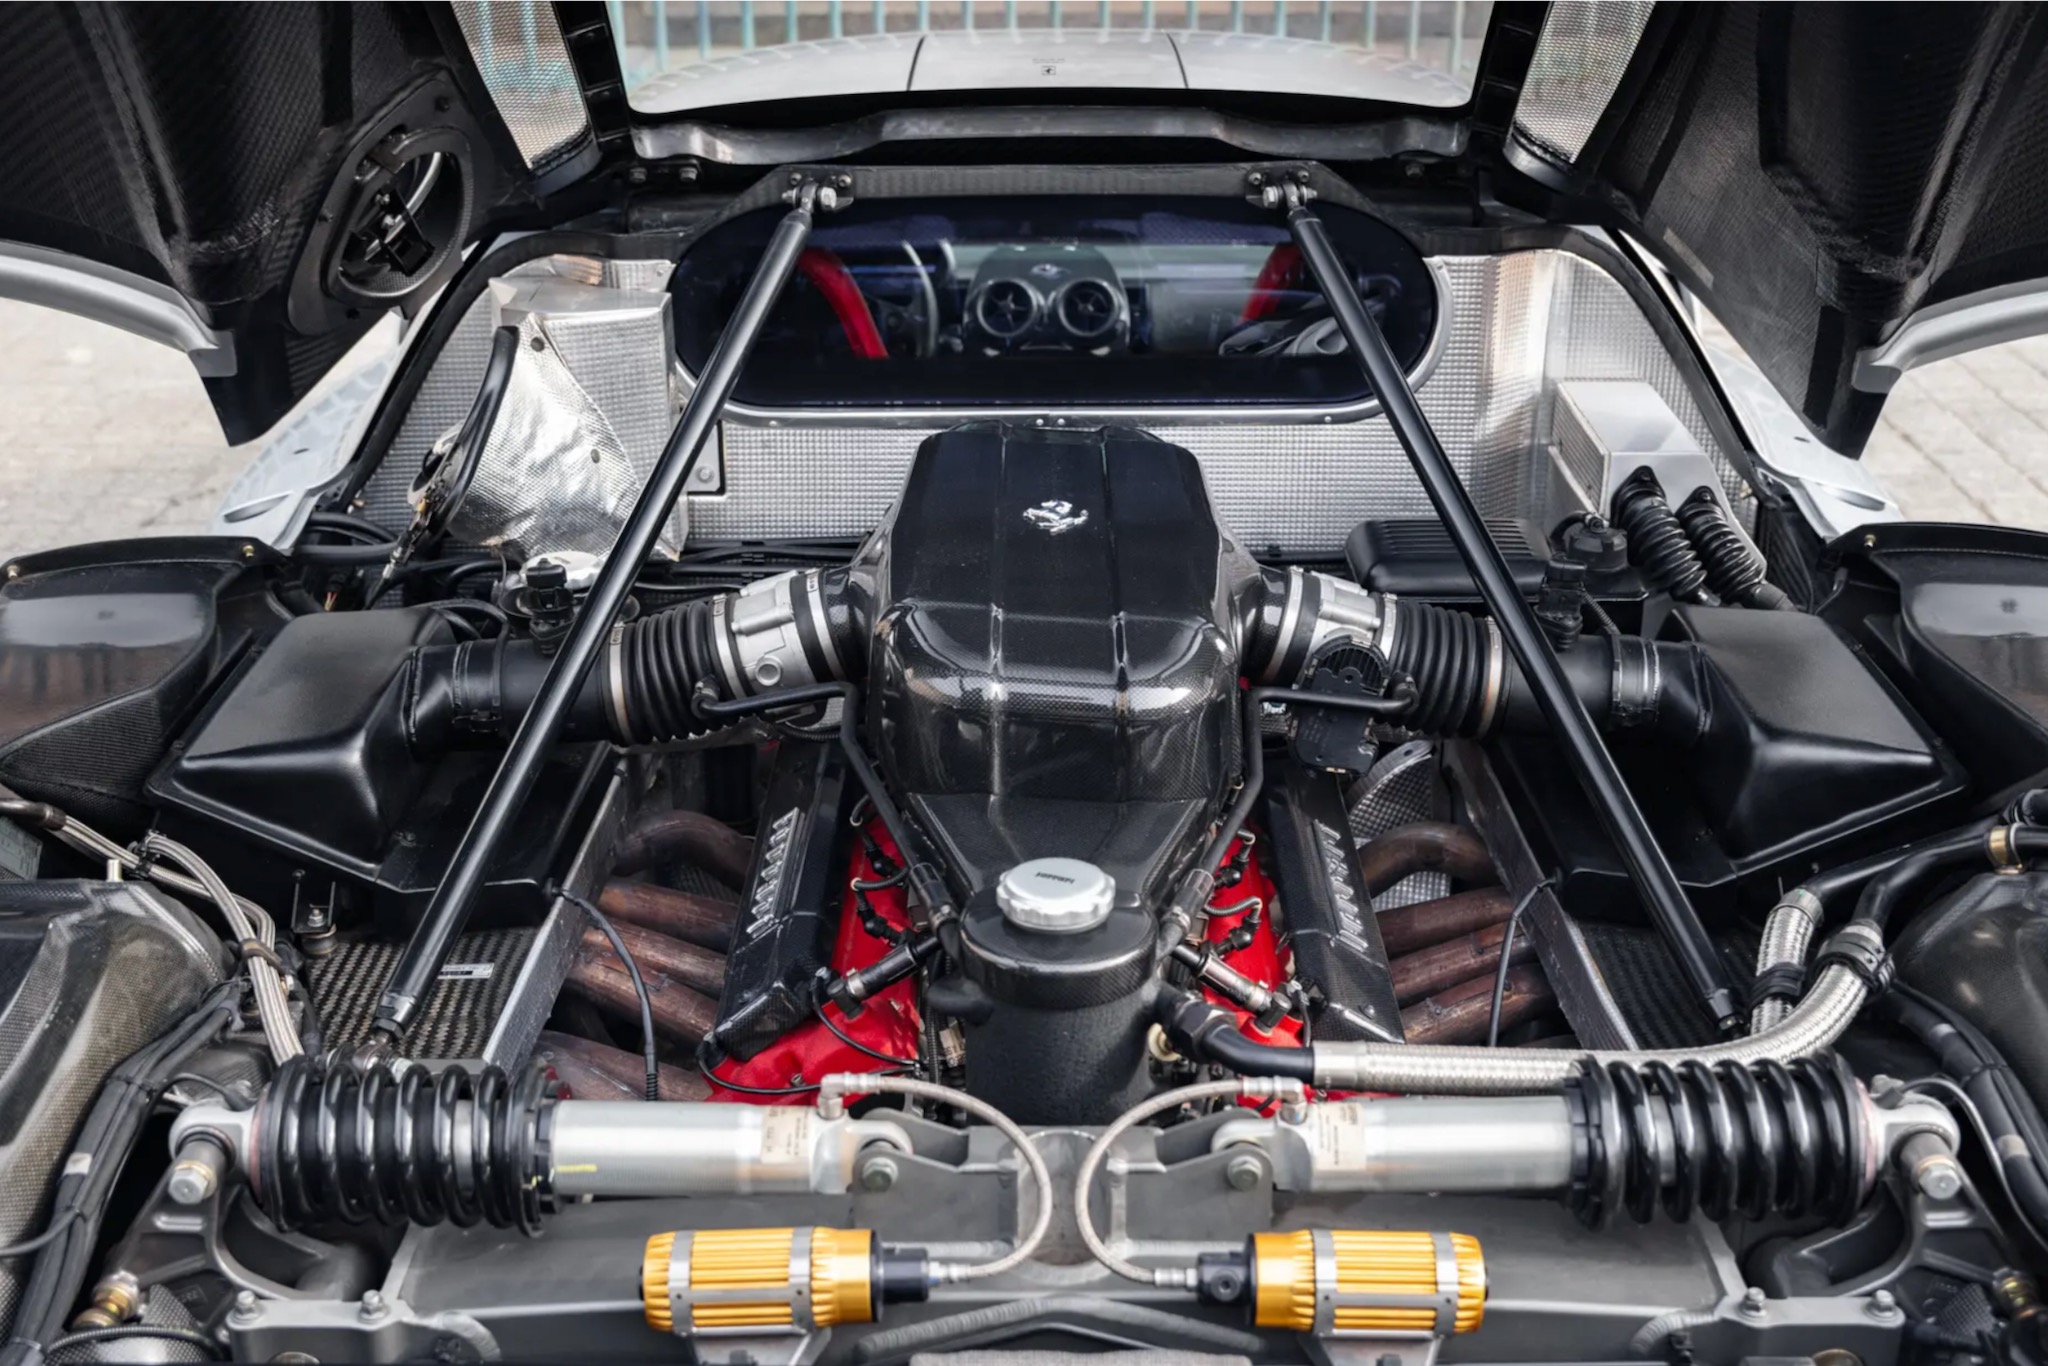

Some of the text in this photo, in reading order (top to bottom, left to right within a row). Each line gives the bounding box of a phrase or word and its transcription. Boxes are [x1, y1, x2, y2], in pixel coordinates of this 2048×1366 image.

[746, 806, 800, 938] Ferrari
[1035, 872, 1075, 883] Ferrari
[1313, 819, 1369, 952] Ferrari
